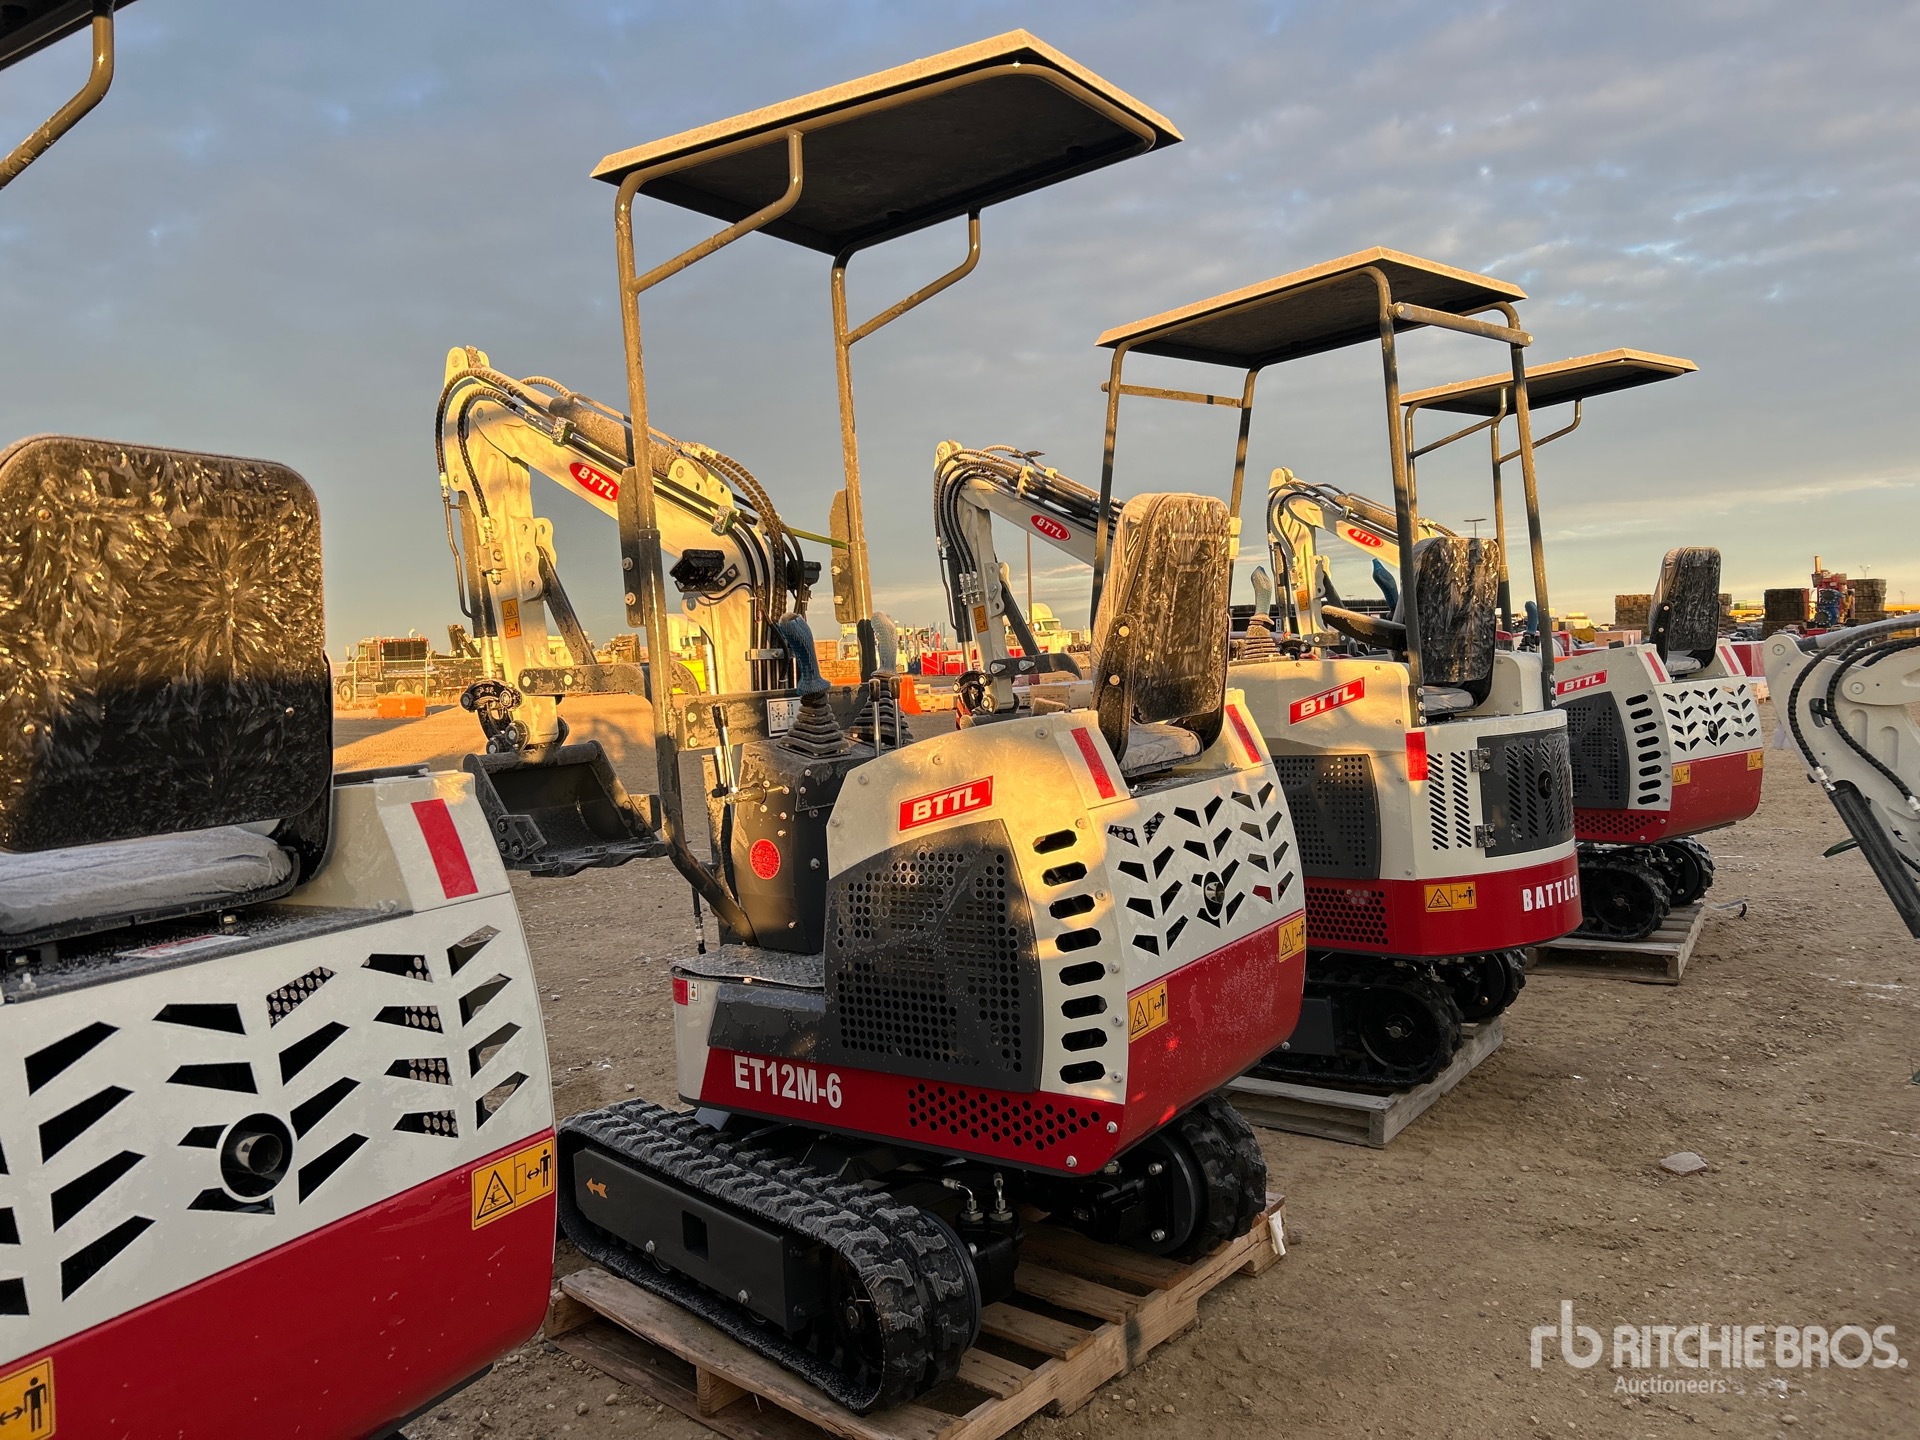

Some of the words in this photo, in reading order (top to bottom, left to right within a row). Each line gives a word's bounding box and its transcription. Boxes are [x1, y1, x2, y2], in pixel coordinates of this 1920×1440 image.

[578, 466, 614, 499] BTTL
[1037, 518, 1062, 538] BTTL
[1353, 530, 1376, 545] BTTL
[1564, 675, 1600, 691] BTTL
[1300, 686, 1356, 717] BTTL
[912, 787, 981, 822] BTTL
[734, 1055, 842, 1109] ET12M-6
